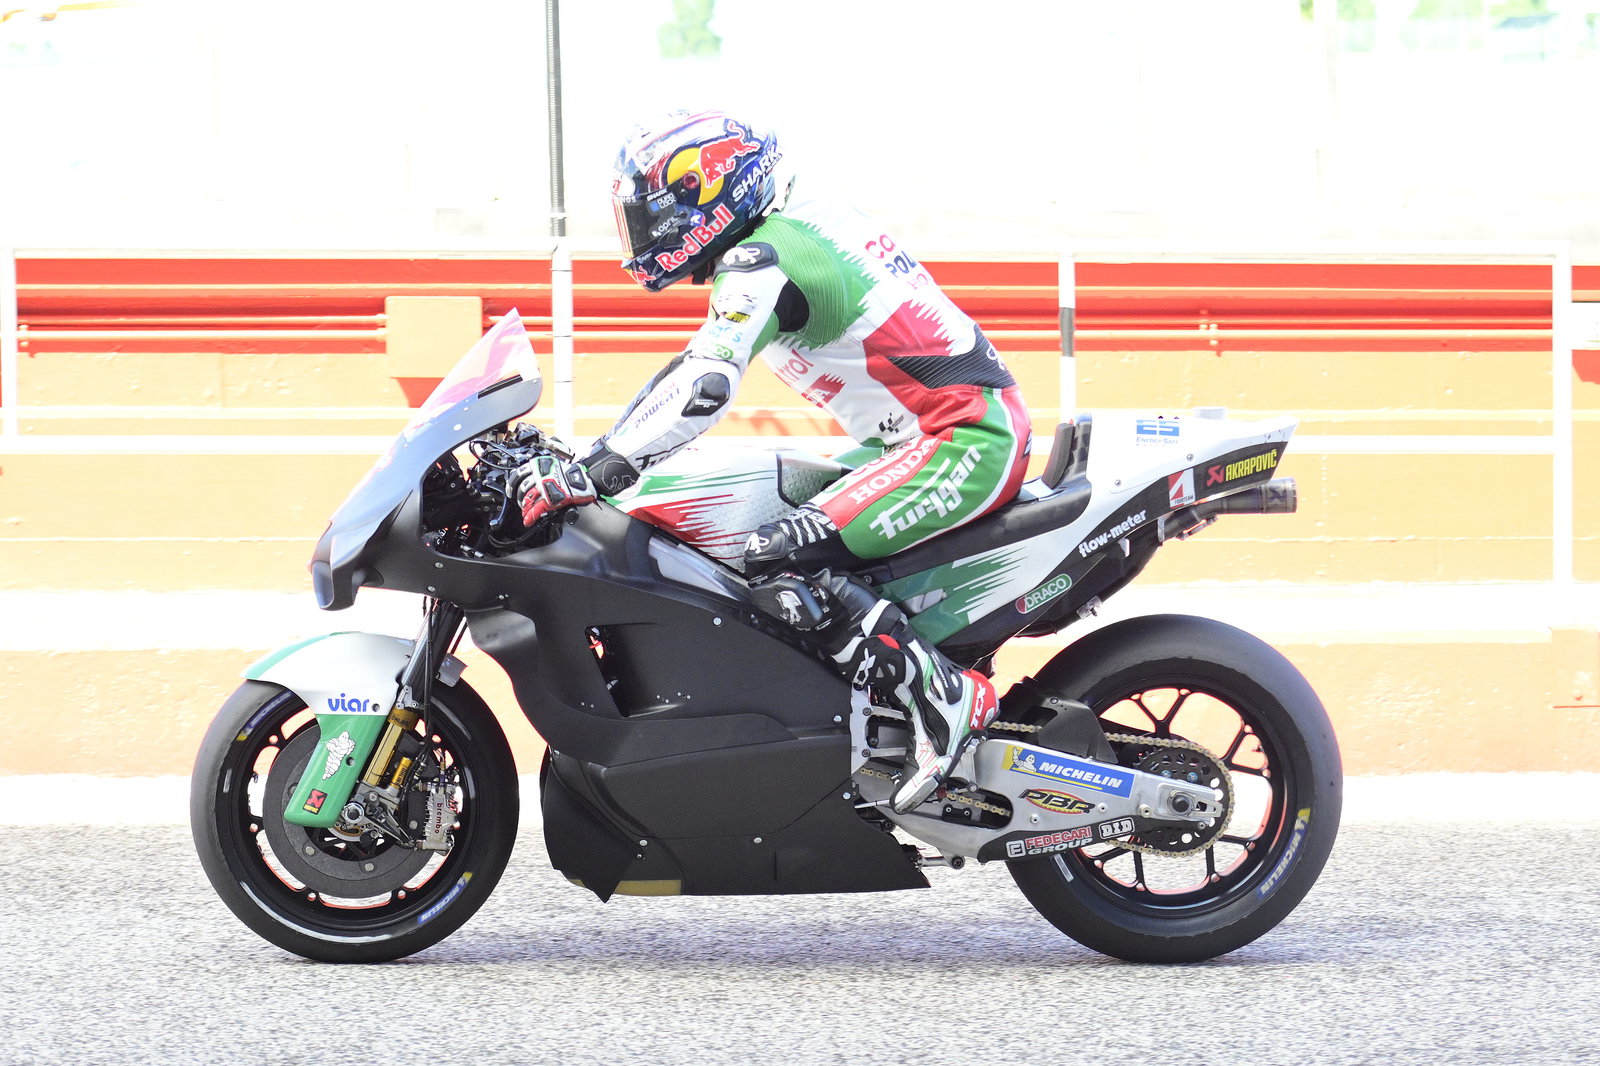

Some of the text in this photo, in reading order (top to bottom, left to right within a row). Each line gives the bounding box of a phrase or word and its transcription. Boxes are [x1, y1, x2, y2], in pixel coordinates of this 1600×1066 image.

[732, 144, 780, 202] SHARK
[655, 203, 736, 272] Red Bull
[848, 437, 939, 505] HONDA
[869, 445, 982, 540] Furygan
[1078, 509, 1146, 558] flow-meter
[1024, 577, 1067, 609] DRACO
[327, 692, 370, 713] viar
[1039, 761, 1123, 789] MICHELIN
[1018, 788, 1096, 814] PBR
[434, 802, 444, 834] brembo
[1025, 825, 1094, 850] FEDEGARI
[1027, 837, 1094, 855] GROUP
